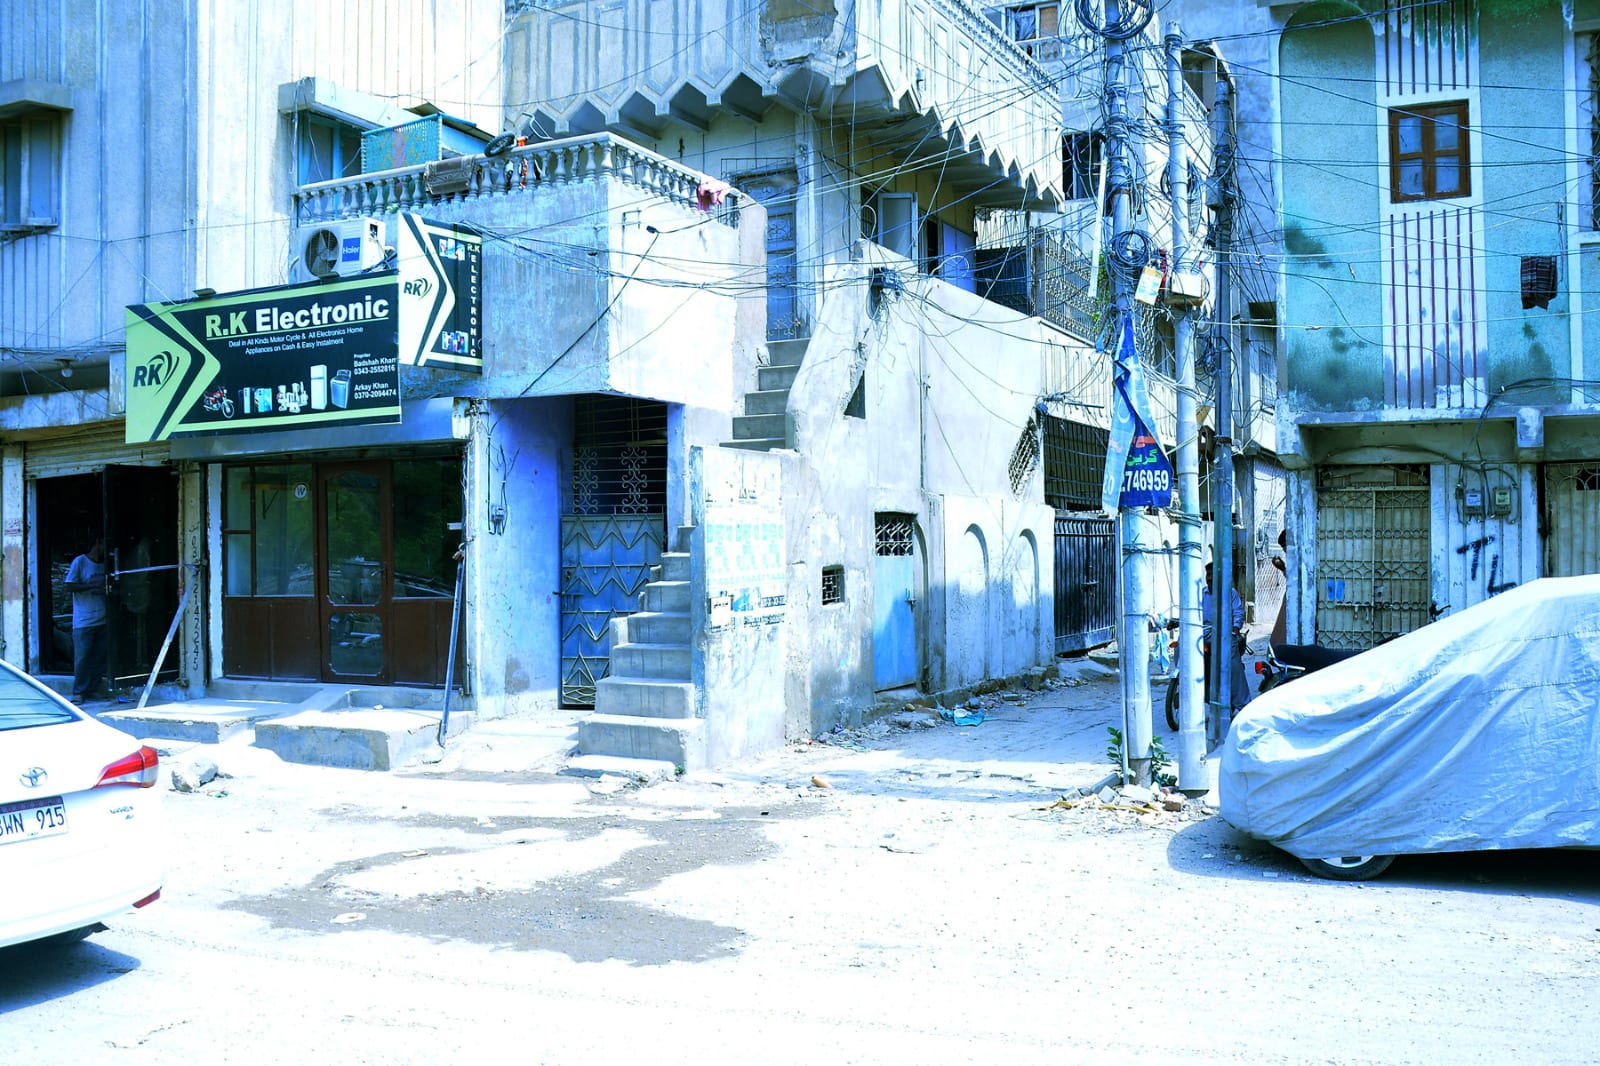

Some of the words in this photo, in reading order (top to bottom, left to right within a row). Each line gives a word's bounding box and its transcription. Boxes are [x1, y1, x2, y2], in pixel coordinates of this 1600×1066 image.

[342, 245, 360, 254] Haier
[467, 243, 481, 253] R.K
[403, 282, 422, 296] RK
[205, 311, 248, 338] R.K
[255, 295, 389, 332] Electronic
[229, 339, 241, 348] Deal
[255, 336, 269, 345] Kinds
[270, 335, 285, 343] Motor
[285, 333, 301, 342] Cycle
[316, 328, 346, 338] Electronics
[346, 326, 364, 334] Home
[245, 346, 274, 355] Appliances
[301, 340, 315, 349] Easy
[315, 337, 344, 345] Instalment
[353, 359, 380, 367] Badshah
[379, 357, 397, 365] Khan
[132, 364, 163, 388] RK
[354, 383, 372, 392] Arkay
[372, 381, 389, 389] Khan
[353, 388, 397, 400] 0370-2094474
[36, 806, 65, 830] 915
